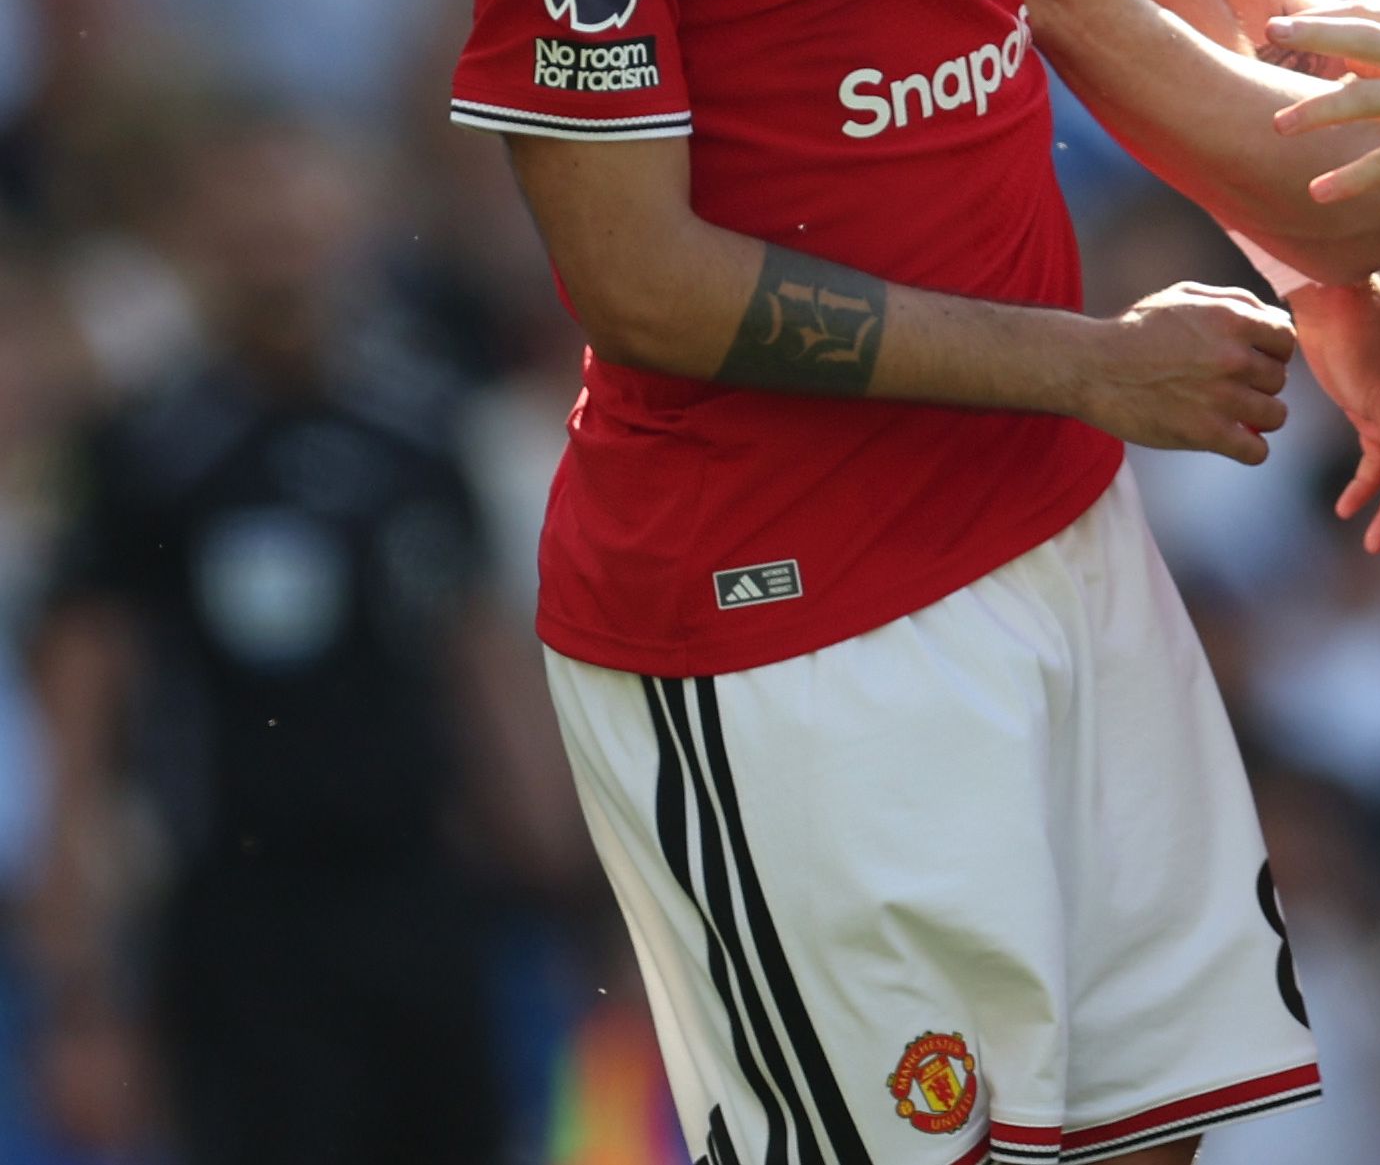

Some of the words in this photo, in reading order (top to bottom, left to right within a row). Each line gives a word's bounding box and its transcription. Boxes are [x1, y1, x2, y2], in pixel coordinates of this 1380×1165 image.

[534, 38, 575, 65] No
[580, 43, 648, 68] room
[534, 59, 573, 88] for
[577, 65, 659, 90] racism
